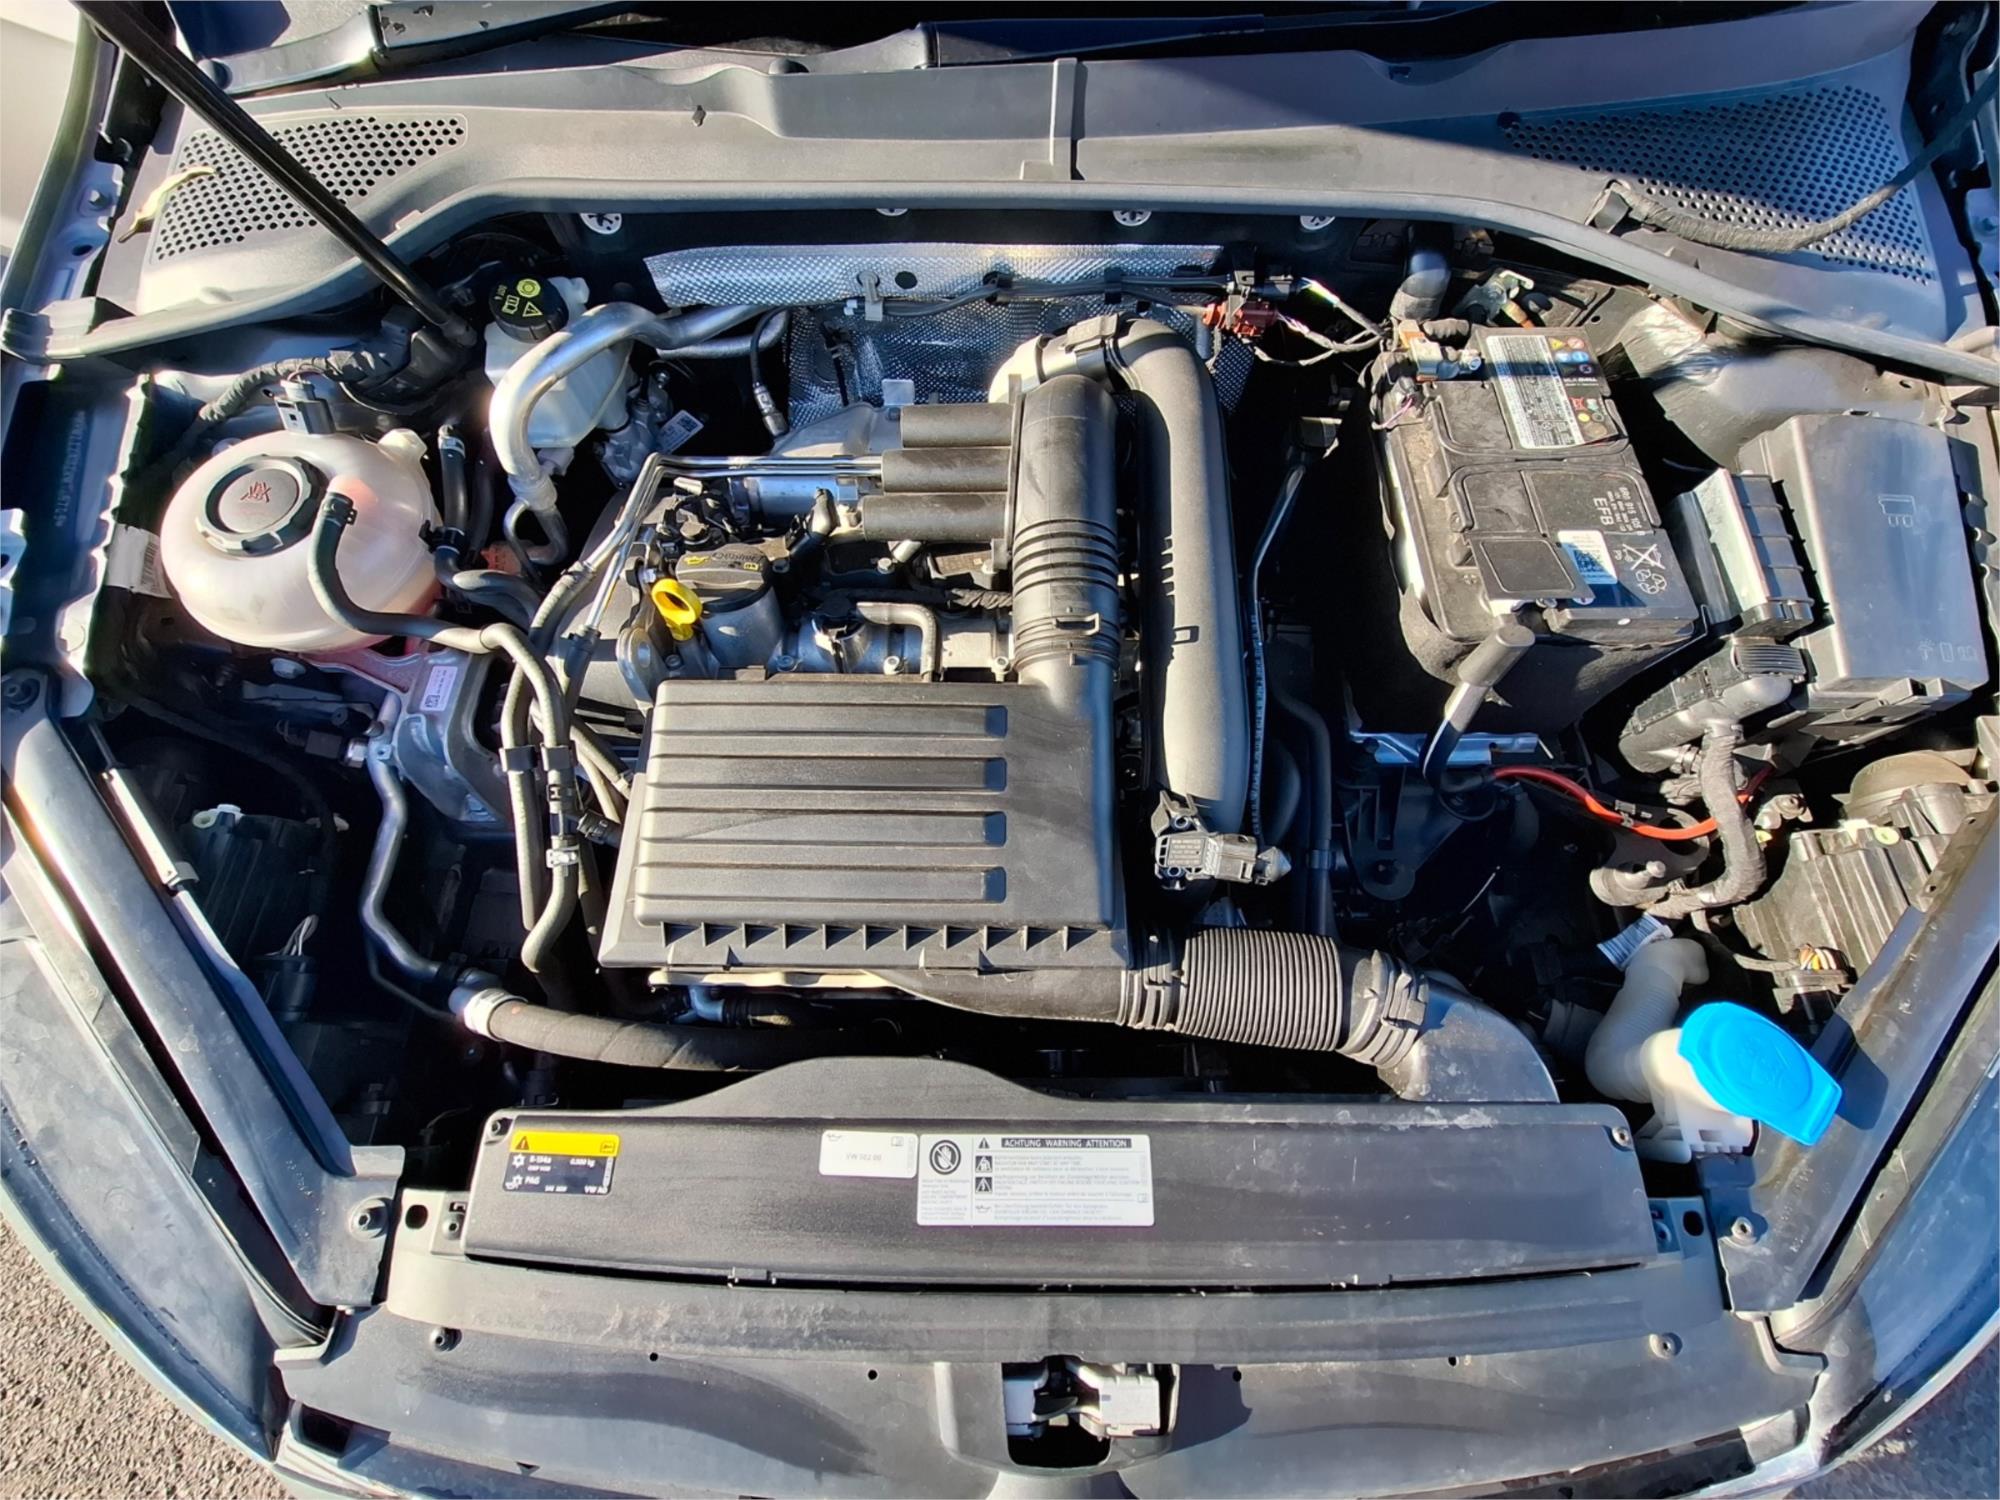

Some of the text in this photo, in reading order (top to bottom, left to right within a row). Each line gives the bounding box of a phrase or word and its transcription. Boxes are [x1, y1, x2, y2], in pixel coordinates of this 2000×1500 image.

[1593, 497, 1615, 526] EFB
[1004, 1138, 1127, 1148] ACHTUNG WARNING ATTENTION
